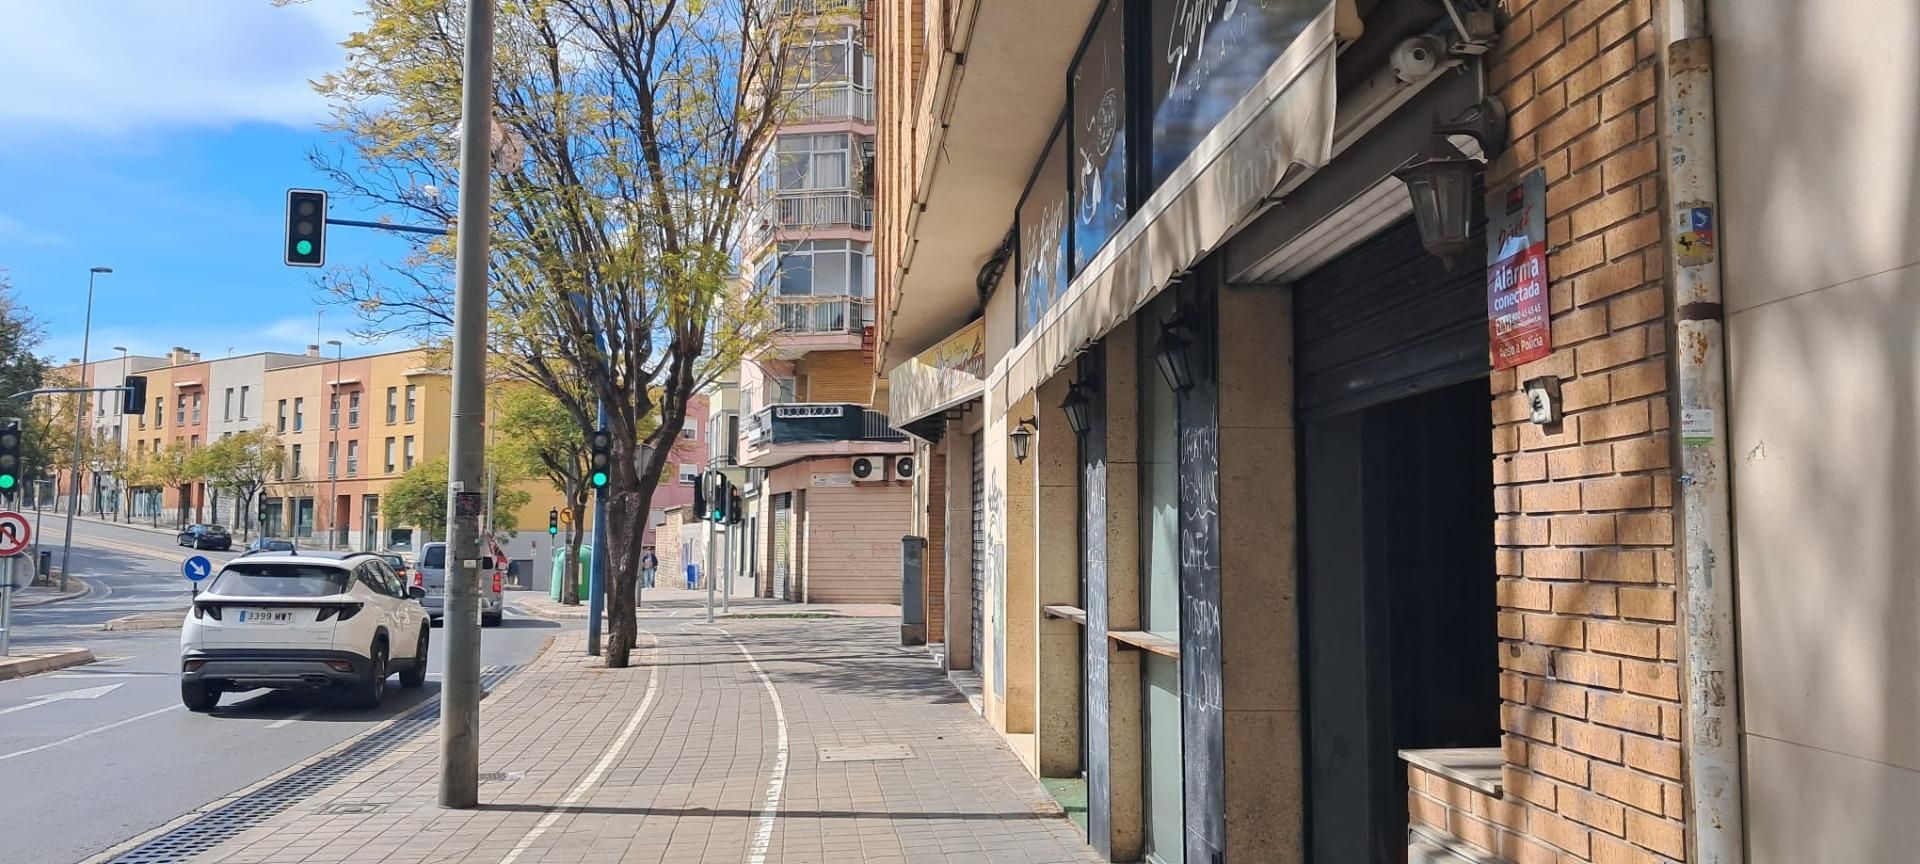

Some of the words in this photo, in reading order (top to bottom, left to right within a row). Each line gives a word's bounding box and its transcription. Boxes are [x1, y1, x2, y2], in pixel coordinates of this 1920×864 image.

[1216, 137, 1281, 221] Vinos
[1494, 257, 1539, 293] Alarma
[1494, 281, 1540, 311] conectada
[1183, 523, 1212, 572] CAFÉ
[248, 612, 272, 621] 3399
[1186, 595, 1221, 642] TOSTADA
